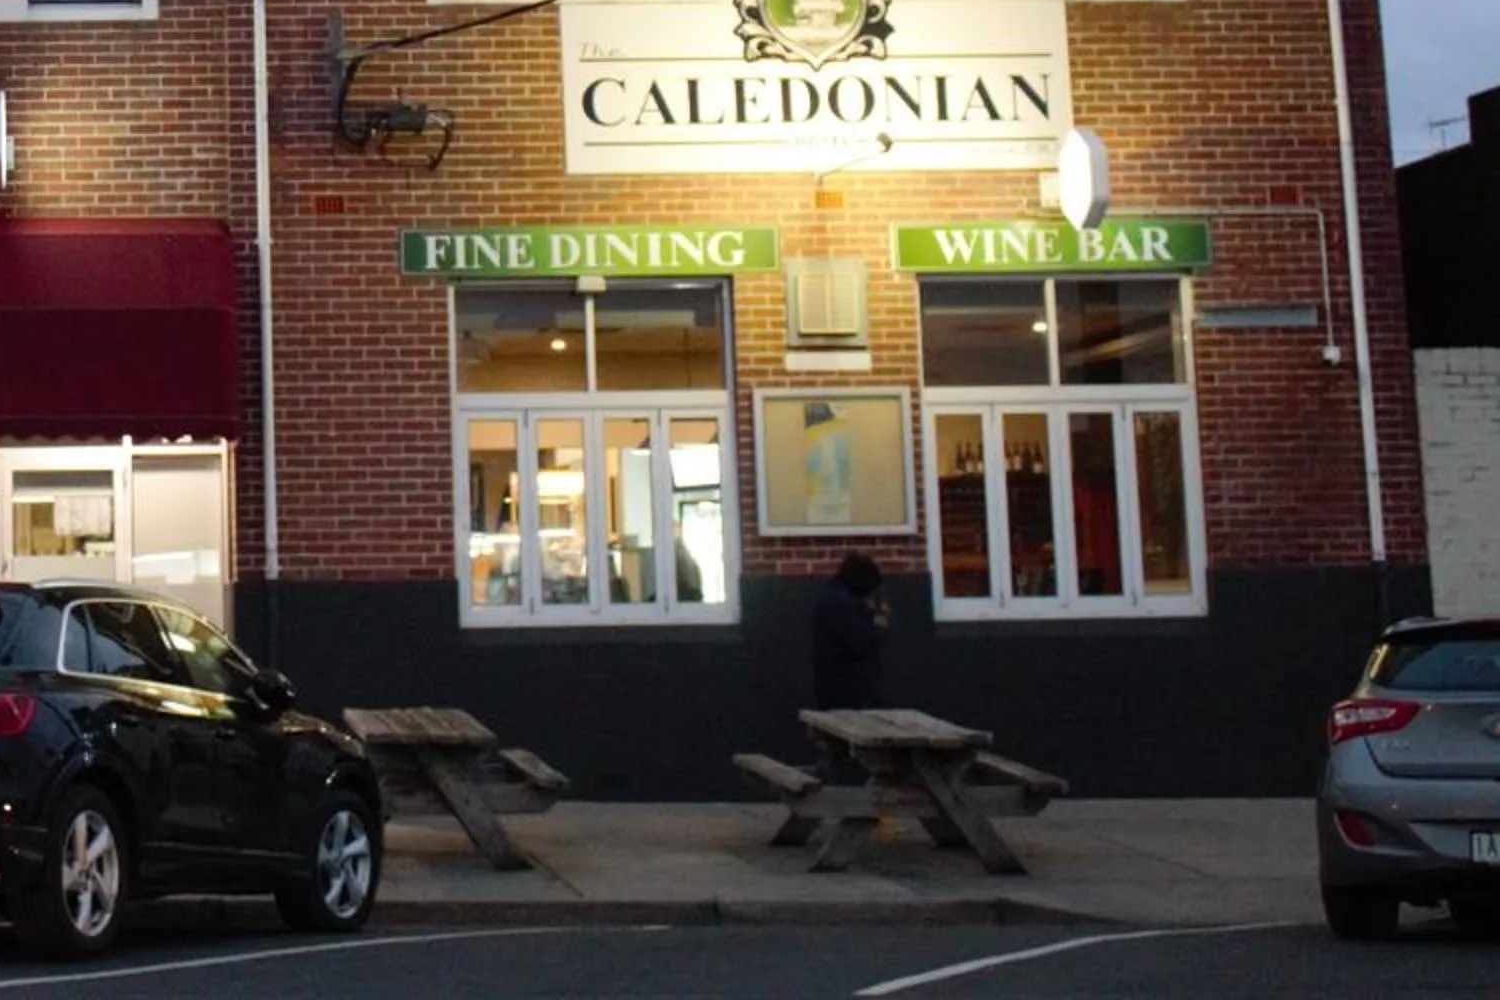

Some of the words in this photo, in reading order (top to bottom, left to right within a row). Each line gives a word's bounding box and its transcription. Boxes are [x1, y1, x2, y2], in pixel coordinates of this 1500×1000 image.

[582, 73, 1051, 127] CALEDONIAN
[423, 234, 535, 269] FINE
[550, 232, 747, 268] DINING
[932, 228, 1063, 264] WINE
[1077, 226, 1174, 262] BAR
